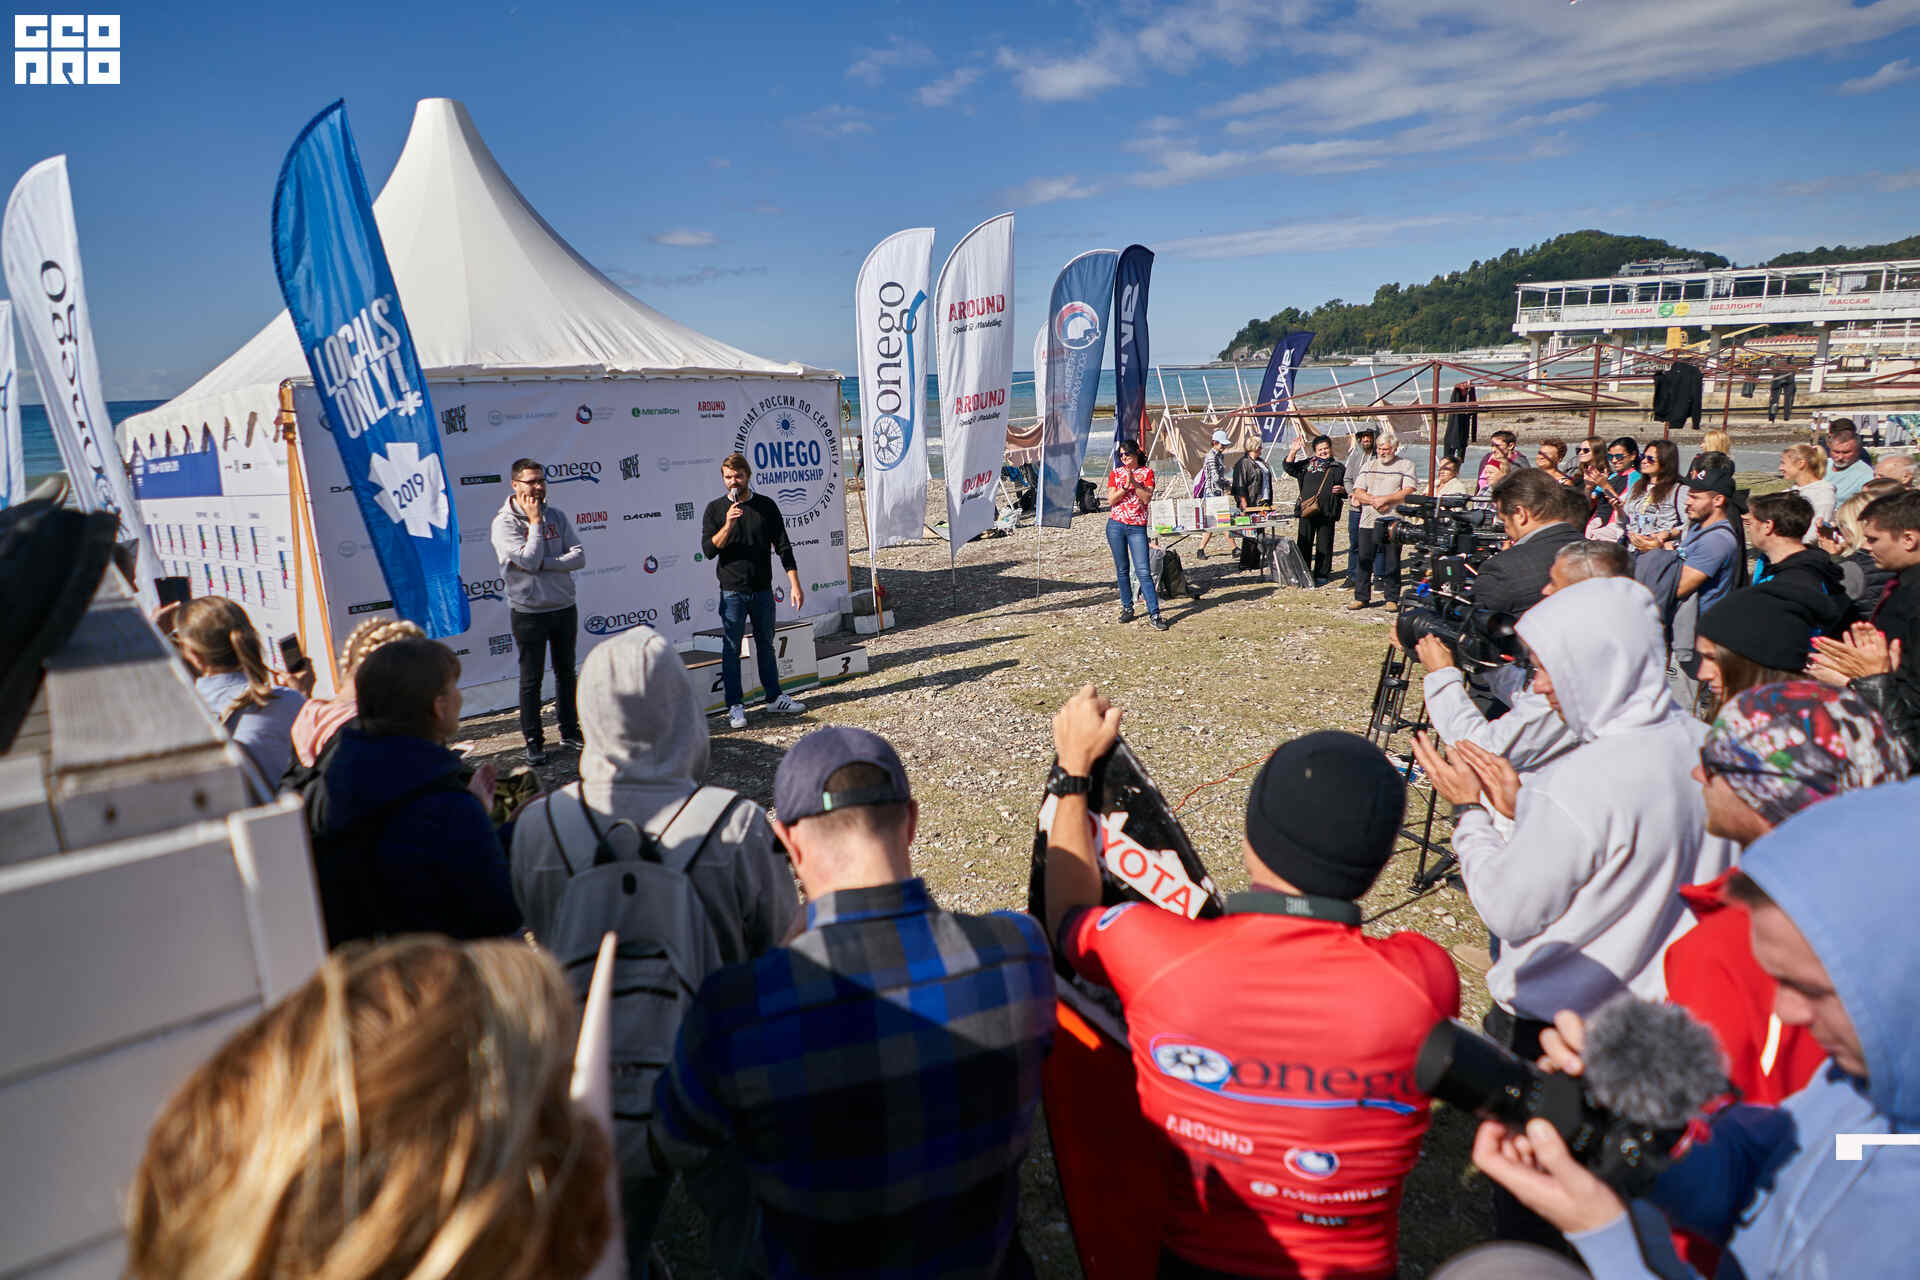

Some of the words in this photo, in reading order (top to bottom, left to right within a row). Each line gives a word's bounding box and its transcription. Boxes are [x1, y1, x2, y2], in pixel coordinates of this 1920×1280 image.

[948, 294, 1006, 322] AROUND
[314, 297, 401, 397] LOCALS
[876, 281, 918, 415] onego
[697, 400, 726, 412] AROUND
[955, 388, 1005, 415] AROUND
[734, 407, 759, 455] ПИОНАТ
[760, 395, 795, 412] РОССИИ
[798, 400, 811, 413] ПО
[754, 440, 820, 470] ONEGO
[545, 461, 602, 479] onego
[755, 468, 824, 485] CHAMPIONSHIP
[962, 470, 993, 494] OUND
[392, 472, 425, 510] 2019
[576, 511, 608, 524] AROUND
[783, 509, 820, 529] КТЯБРЬ
[820, 482, 836, 509] 2019
[605, 608, 658, 628] onego
[838, 656, 851, 676] 3
[1100, 825, 1193, 918] YOTA
[1165, 1114, 1254, 1155] AROUND
